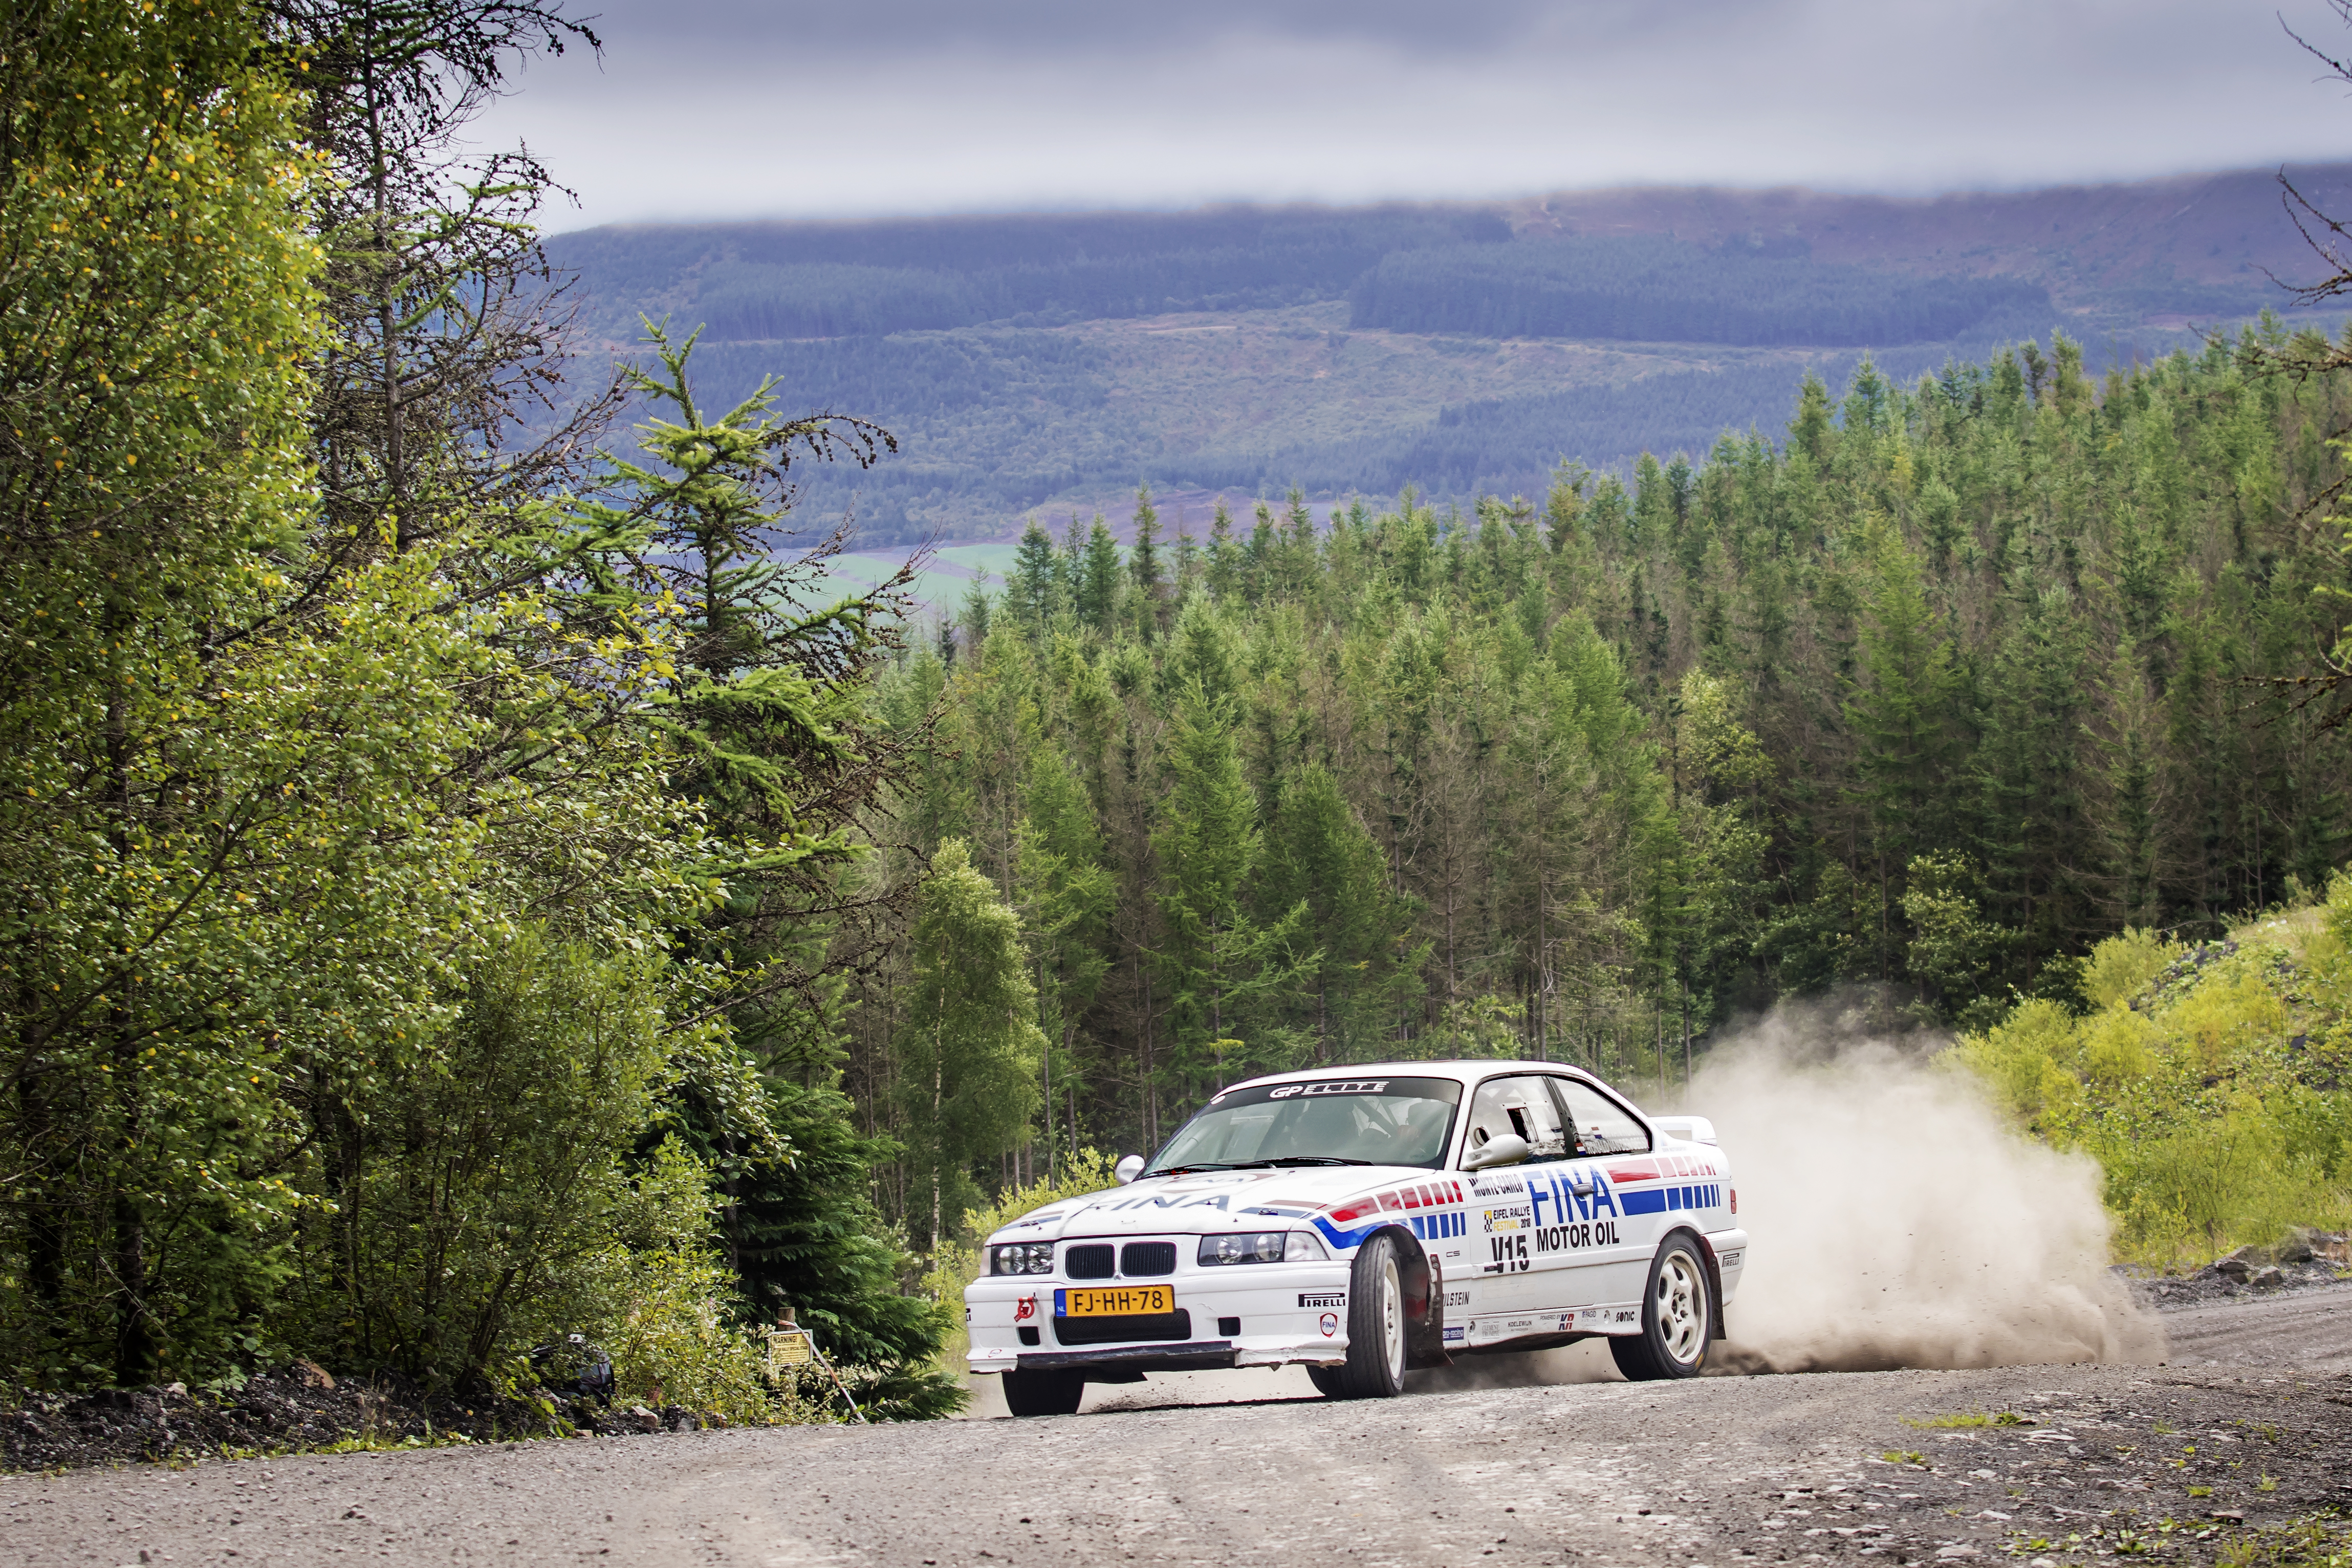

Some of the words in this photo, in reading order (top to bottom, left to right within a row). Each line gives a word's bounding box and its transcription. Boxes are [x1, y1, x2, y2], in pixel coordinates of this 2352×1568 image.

[1468, 1173, 1523, 1197] MONTE-CARLO
[1522, 1165, 1618, 1227] FINA
[1493, 1209, 1509, 1219] EIFEL
[1510, 1206, 1530, 1217] RALLYE
[1493, 1219, 1519, 1232] FESTIVAL
[1520, 1217, 1531, 1228] 2018
[1536, 1224, 1591, 1252] MOTOR
[1595, 1221, 1620, 1246] OIL
[1722, 1252, 1740, 1268] PIRELLI
[1074, 1290, 1163, 1312] FJ-HH-78
[1298, 1293, 1346, 1308] PIRELLI
